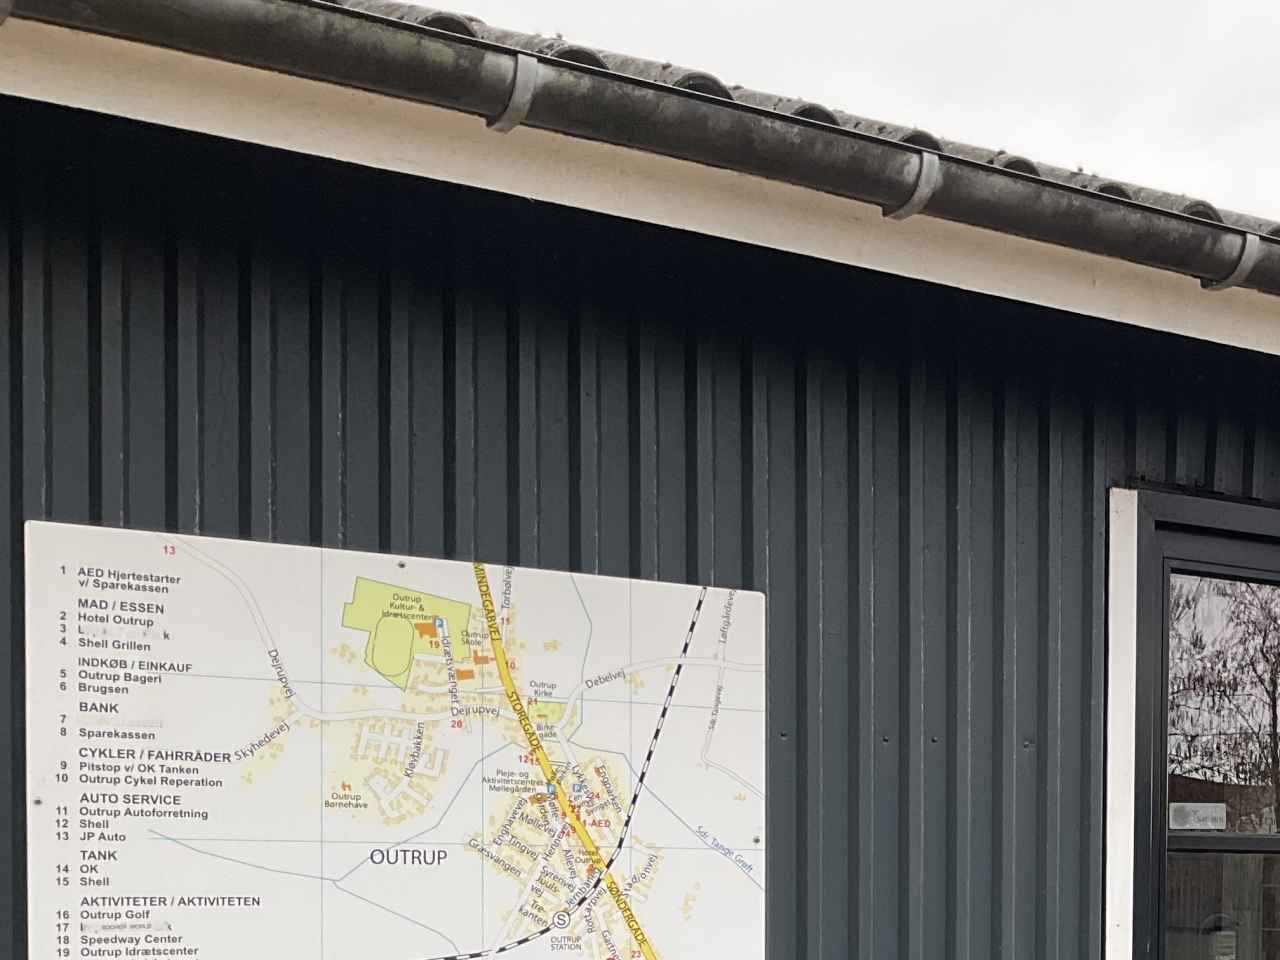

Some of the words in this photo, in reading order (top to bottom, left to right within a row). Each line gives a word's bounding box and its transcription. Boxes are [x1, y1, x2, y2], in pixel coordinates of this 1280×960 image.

[163, 545, 176, 556] 13
[60, 565, 66, 575] 1
[78, 567, 104, 578] AED
[108, 569, 181, 585] Hjertestarter
[78, 579, 89, 587] v/
[93, 579, 169, 593] Sparekassen
[393, 592, 422, 603] Outrup
[78, 598, 108, 610] MAD
[120, 601, 164, 614] ESSEN
[60, 611, 66, 621] 2
[78, 613, 109, 623] Hotel
[113, 615, 154, 628] Outrup
[60, 624, 66, 633] 3
[60, 637, 66, 646] 4
[78, 637, 108, 648] Shell
[112, 640, 151, 651] Grillen
[78, 657, 128, 669] INDKØB
[138, 661, 193, 673] EINKAUF
[60, 669, 66, 678] 5
[78, 670, 120, 683] Outrup
[124, 673, 162, 685] Bageri
[268, 649, 297, 699] Dejrupvej
[585, 669, 627, 689] Debelvej
[60, 682, 66, 691] 6
[78, 683, 128, 695] Brugsen
[530, 680, 557, 689] Outrup
[79, 702, 119, 713] BANK
[451, 706, 501, 718] Dejrupvej
[60, 715, 66, 723] 7
[451, 720, 463, 728] 20
[508, 691, 544, 753] STOREGADE
[60, 728, 66, 736] 8
[79, 728, 155, 740] Sparekassen
[79, 747, 136, 760] CYKLER
[60, 761, 67, 770] 9
[79, 762, 120, 774] Pitstop
[137, 763, 155, 773] OK
[160, 765, 199, 775] Tanken
[55, 774, 68, 783] 10
[79, 774, 120, 786] Outrup
[124, 775, 157, 787] Cykel
[161, 776, 223, 788] Reperation
[80, 793, 119, 804] AUTO
[123, 794, 182, 805] SERVICE
[331, 792, 362, 801] Outrup
[56, 807, 68, 815] 11
[79, 807, 121, 818] Outrup
[124, 808, 208, 821] Autoforretning
[56, 819, 69, 828] 12
[79, 819, 109, 829] Shell
[493, 796, 528, 846] Enghavevej
[56, 832, 69, 841] 13
[79, 832, 95, 841] JP
[99, 832, 126, 842] Auto
[509, 834, 539, 861] Tingvej
[80, 850, 117, 861] TANK
[370, 849, 448, 865] OUTRUP
[468, 838, 522, 877] Græsvangen
[56, 864, 69, 873] 14
[79, 864, 99, 874] OK
[56, 877, 69, 886] 15
[79, 877, 110, 887] Shell
[540, 865, 577, 893] Syrenvej
[530, 886, 544, 898] vej
[80, 896, 168, 907] AKTIVITETER
[178, 896, 261, 907] AKTIVITETEN
[56, 911, 70, 919] 16
[80, 910, 122, 921] Outrup
[125, 909, 151, 919] Golf
[518, 908, 548, 928] kanten
[606, 880, 648, 945] SØNDERGADE
[556, 913, 567, 926] S
[56, 923, 69, 932] 17
[56, 935, 70, 945] 18
[80, 935, 141, 946] Speedway
[144, 934, 183, 944] Center
[550, 936, 582, 944] OUTRUP
[56, 948, 70, 957] 19
[80, 948, 122, 958] Outrup
[125, 946, 199, 957] Idrætscenter
